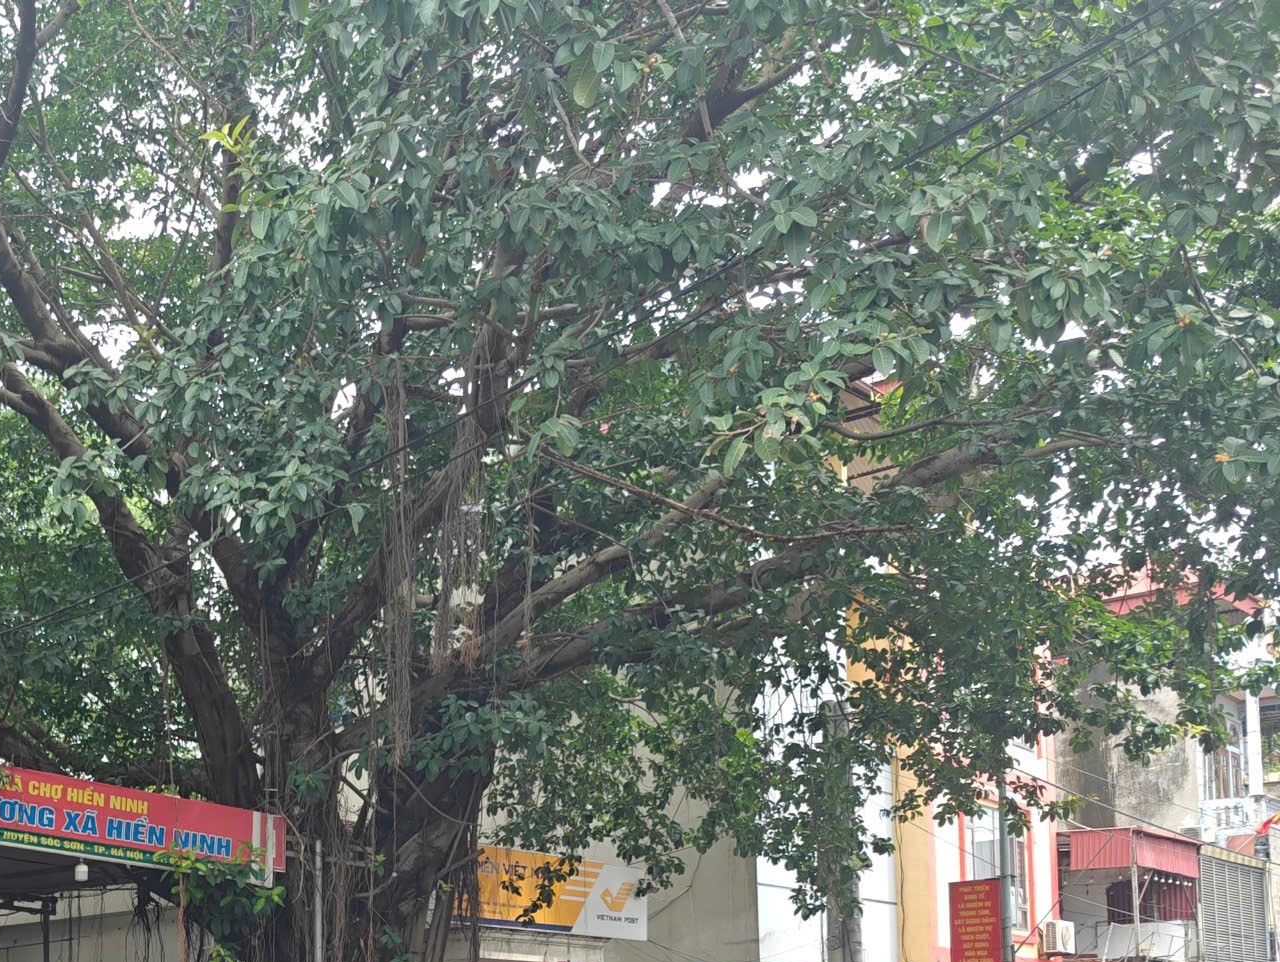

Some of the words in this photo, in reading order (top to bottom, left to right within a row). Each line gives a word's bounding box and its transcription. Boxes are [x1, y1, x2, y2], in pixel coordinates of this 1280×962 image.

[28, 780, 64, 802] CHỢ
[66, 786, 105, 808] HIỀN
[109, 796, 148, 815] NINH
[62, 809, 99, 837] XÃ
[105, 815, 166, 848] HIỀN
[173, 828, 233, 858] NINH
[596, 913, 623, 923] VIETNAM
[624, 916, 640, 925] POST
